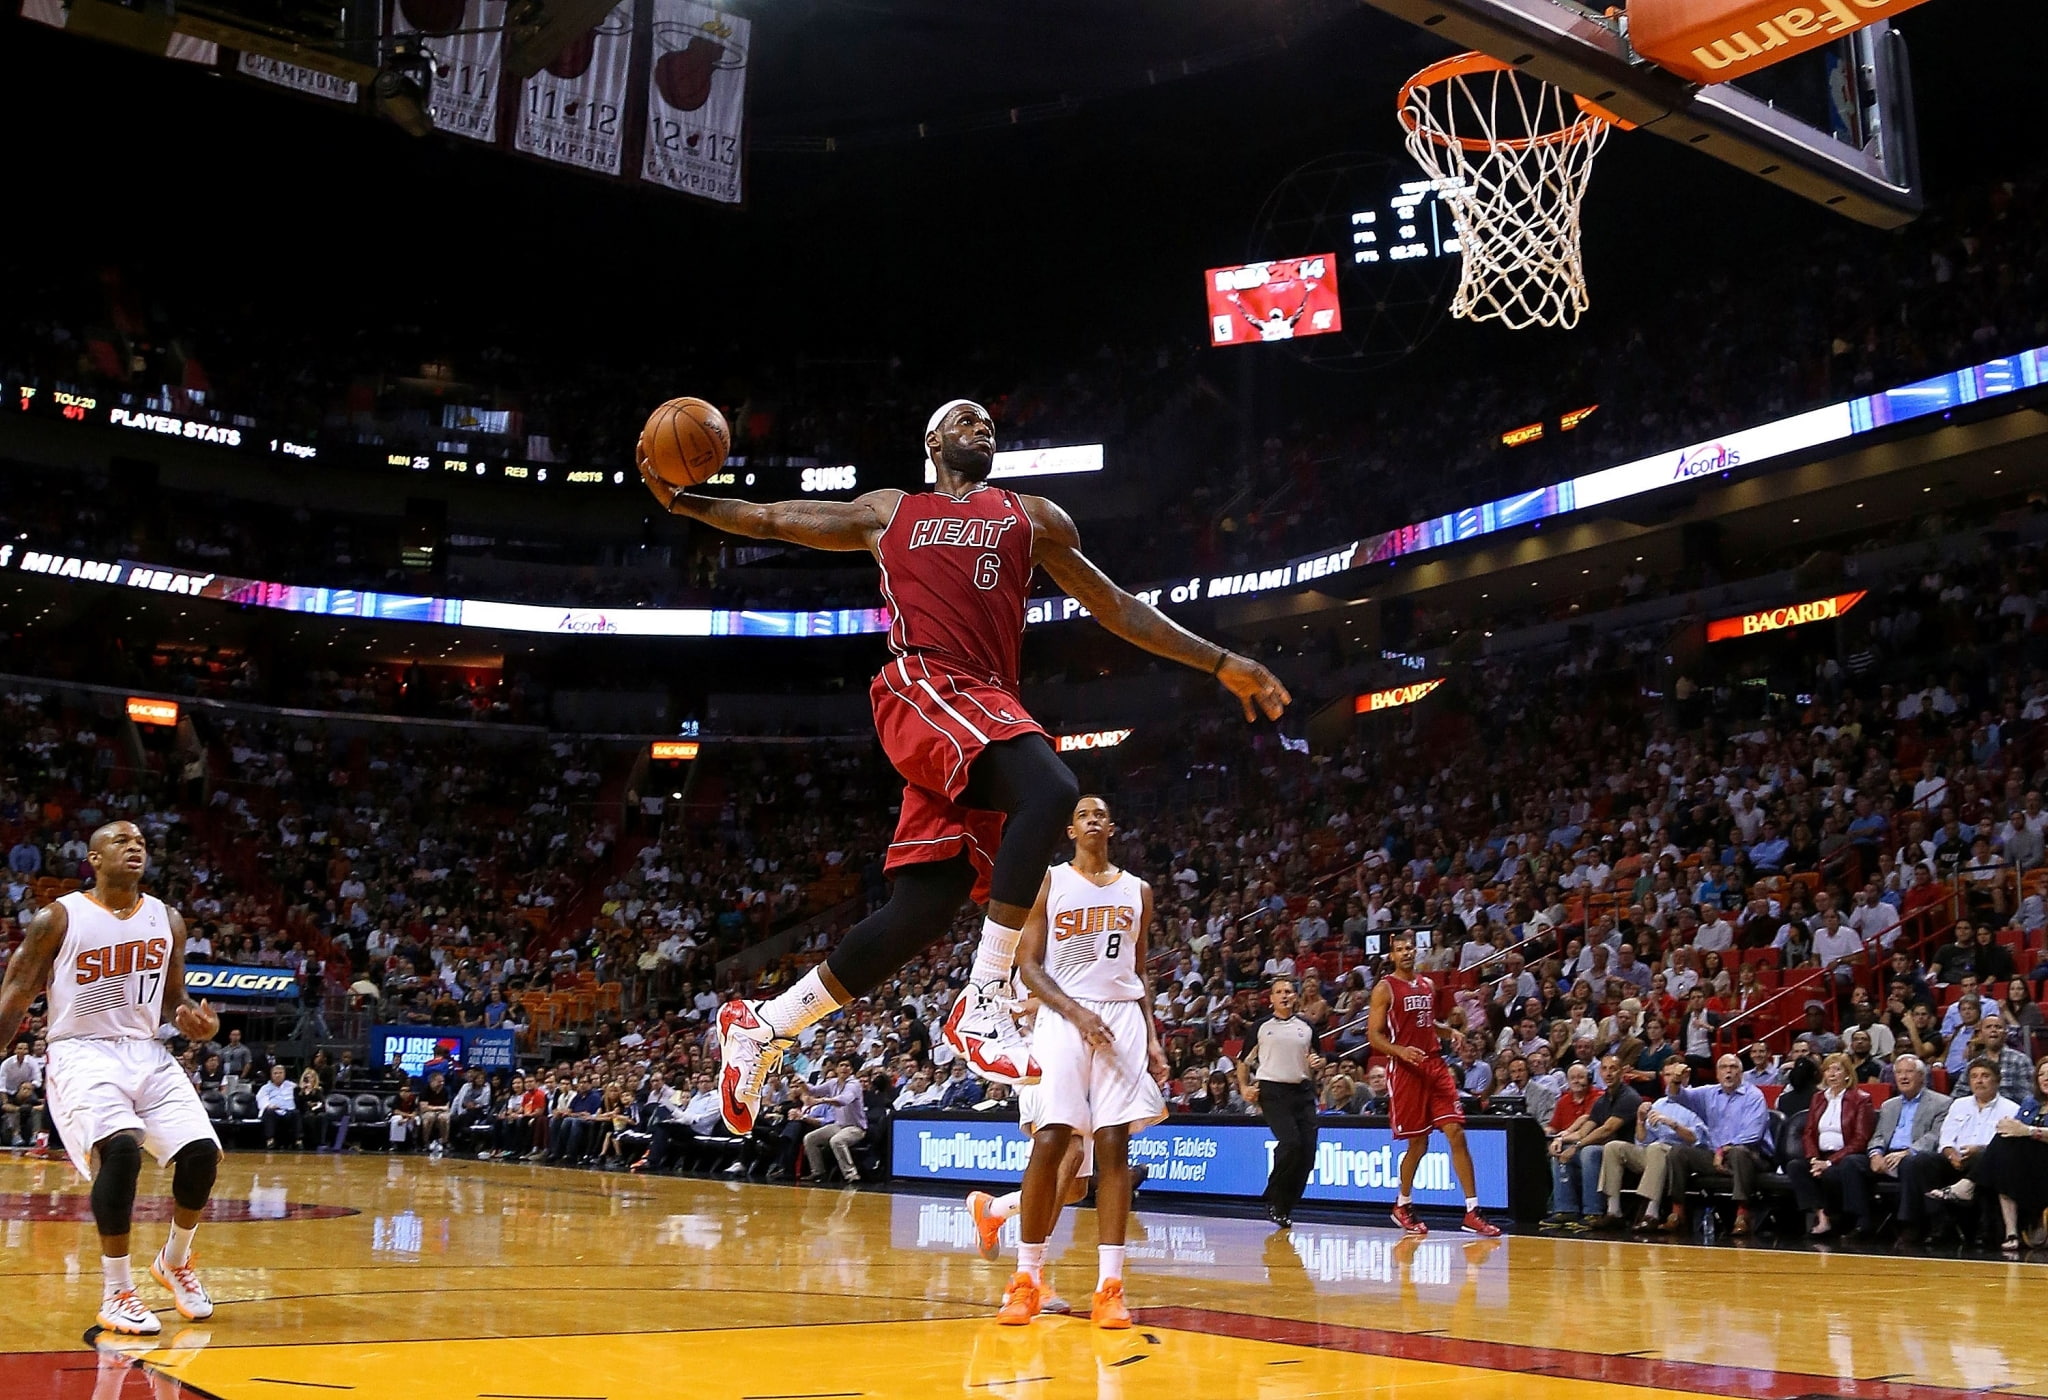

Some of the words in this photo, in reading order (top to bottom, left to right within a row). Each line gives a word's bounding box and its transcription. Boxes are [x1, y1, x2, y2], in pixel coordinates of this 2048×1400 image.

[1691, 0, 1862, 70] Farm
[245, 52, 351, 96] CHAMPIONS
[461, 65, 489, 99] 11
[528, 85, 557, 120] 11
[587, 102, 618, 136] 12
[652, 117, 681, 152] 12
[708, 133, 737, 166] 13
[110, 407, 183, 436] PLAYER
[182, 421, 242, 446] STATS
[412, 455, 430, 470] 25
[444, 460, 468, 473] PTS
[475, 461, 487, 475] 6
[504, 466, 528, 478] REB
[537, 468, 547, 481] 5
[745, 472, 756, 486] 0
[801, 465, 857, 492] SUNS
[908, 515, 1018, 551] HEAT
[0, 544, 13, 567] f
[974, 553, 1001, 590] 6
[1170, 578, 1201, 604] of
[1207, 566, 1292, 599] MIAMI
[1295, 540, 1359, 584] HEAT
[20, 551, 123, 584] MIAMI
[127, 568, 215, 596] HEAT
[1743, 598, 1840, 636] BACARDI
[1106, 933, 1121, 959] 8
[136, 972, 161, 1005] 17
[212, 971, 295, 992] LIGHT
[1403, 993, 1433, 1012] HEAT
[385, 1036, 405, 1054] DJ
[406, 1037, 437, 1054] IRIE
[918, 1131, 1031, 1173] TigerDirect.co
[1127, 1136, 1169, 1159] aptops,
[1172, 1137, 1218, 1159] Tablets
[1168, 1160, 1207, 1182] More!
